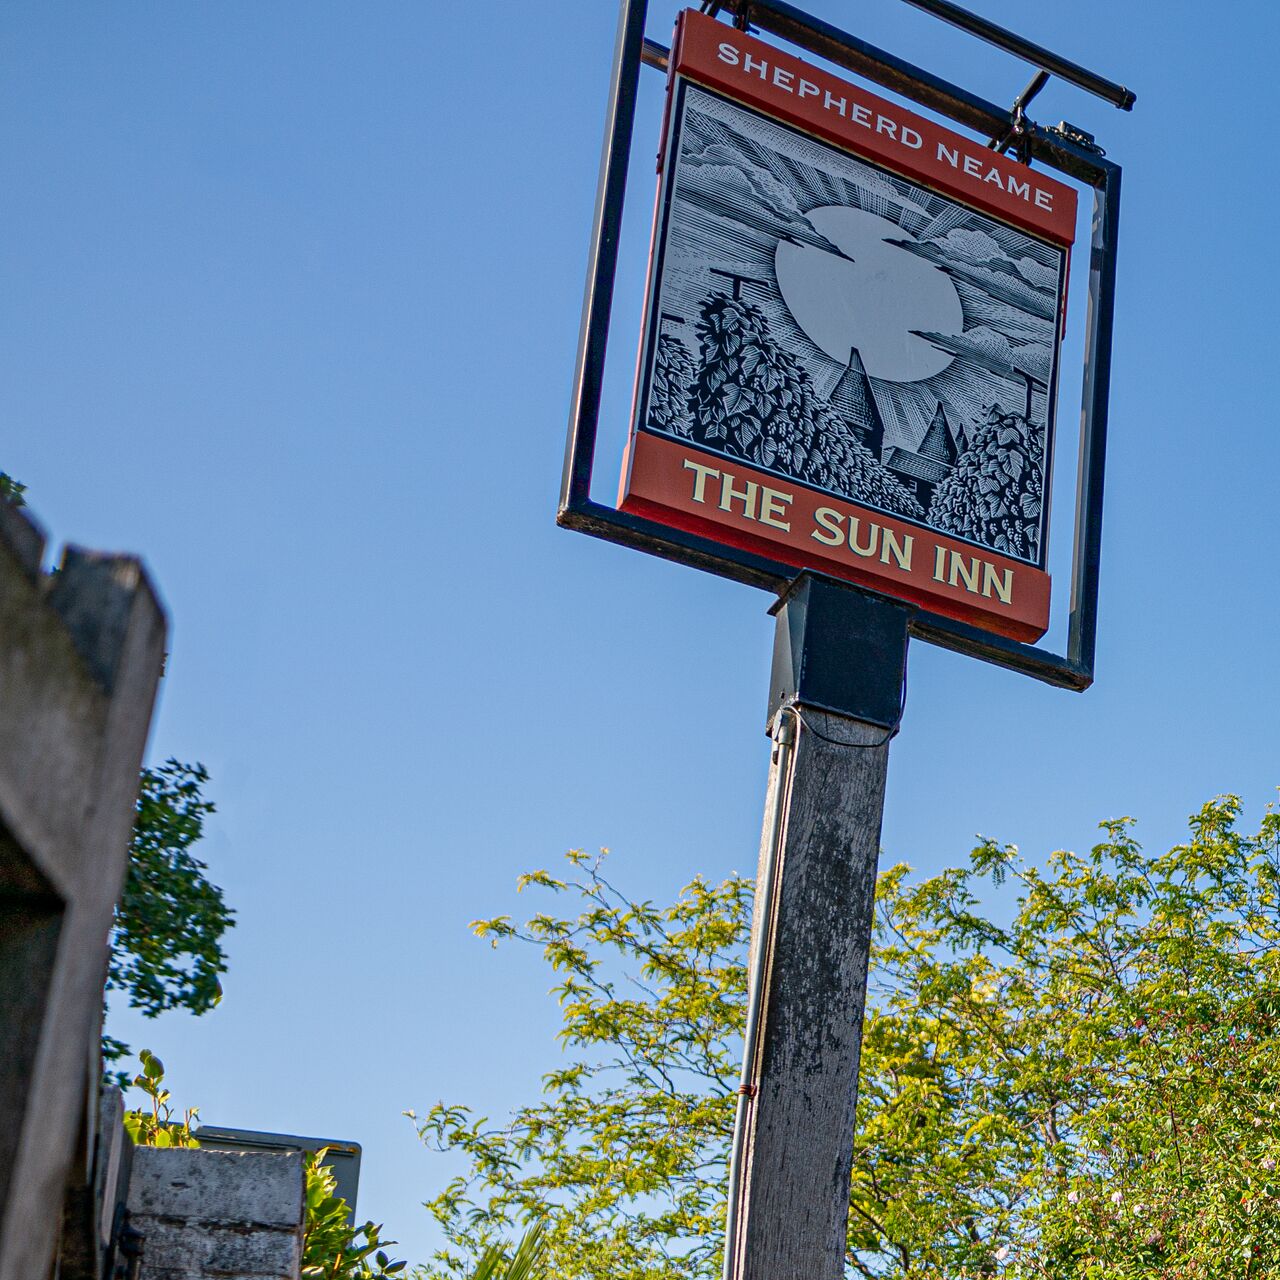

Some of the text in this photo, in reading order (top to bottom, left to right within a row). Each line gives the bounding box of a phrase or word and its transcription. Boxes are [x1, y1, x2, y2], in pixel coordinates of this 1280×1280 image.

[717, 42, 1053, 212] SHEPHERD NEAME
[683, 458, 1014, 605] THE SUN INN
